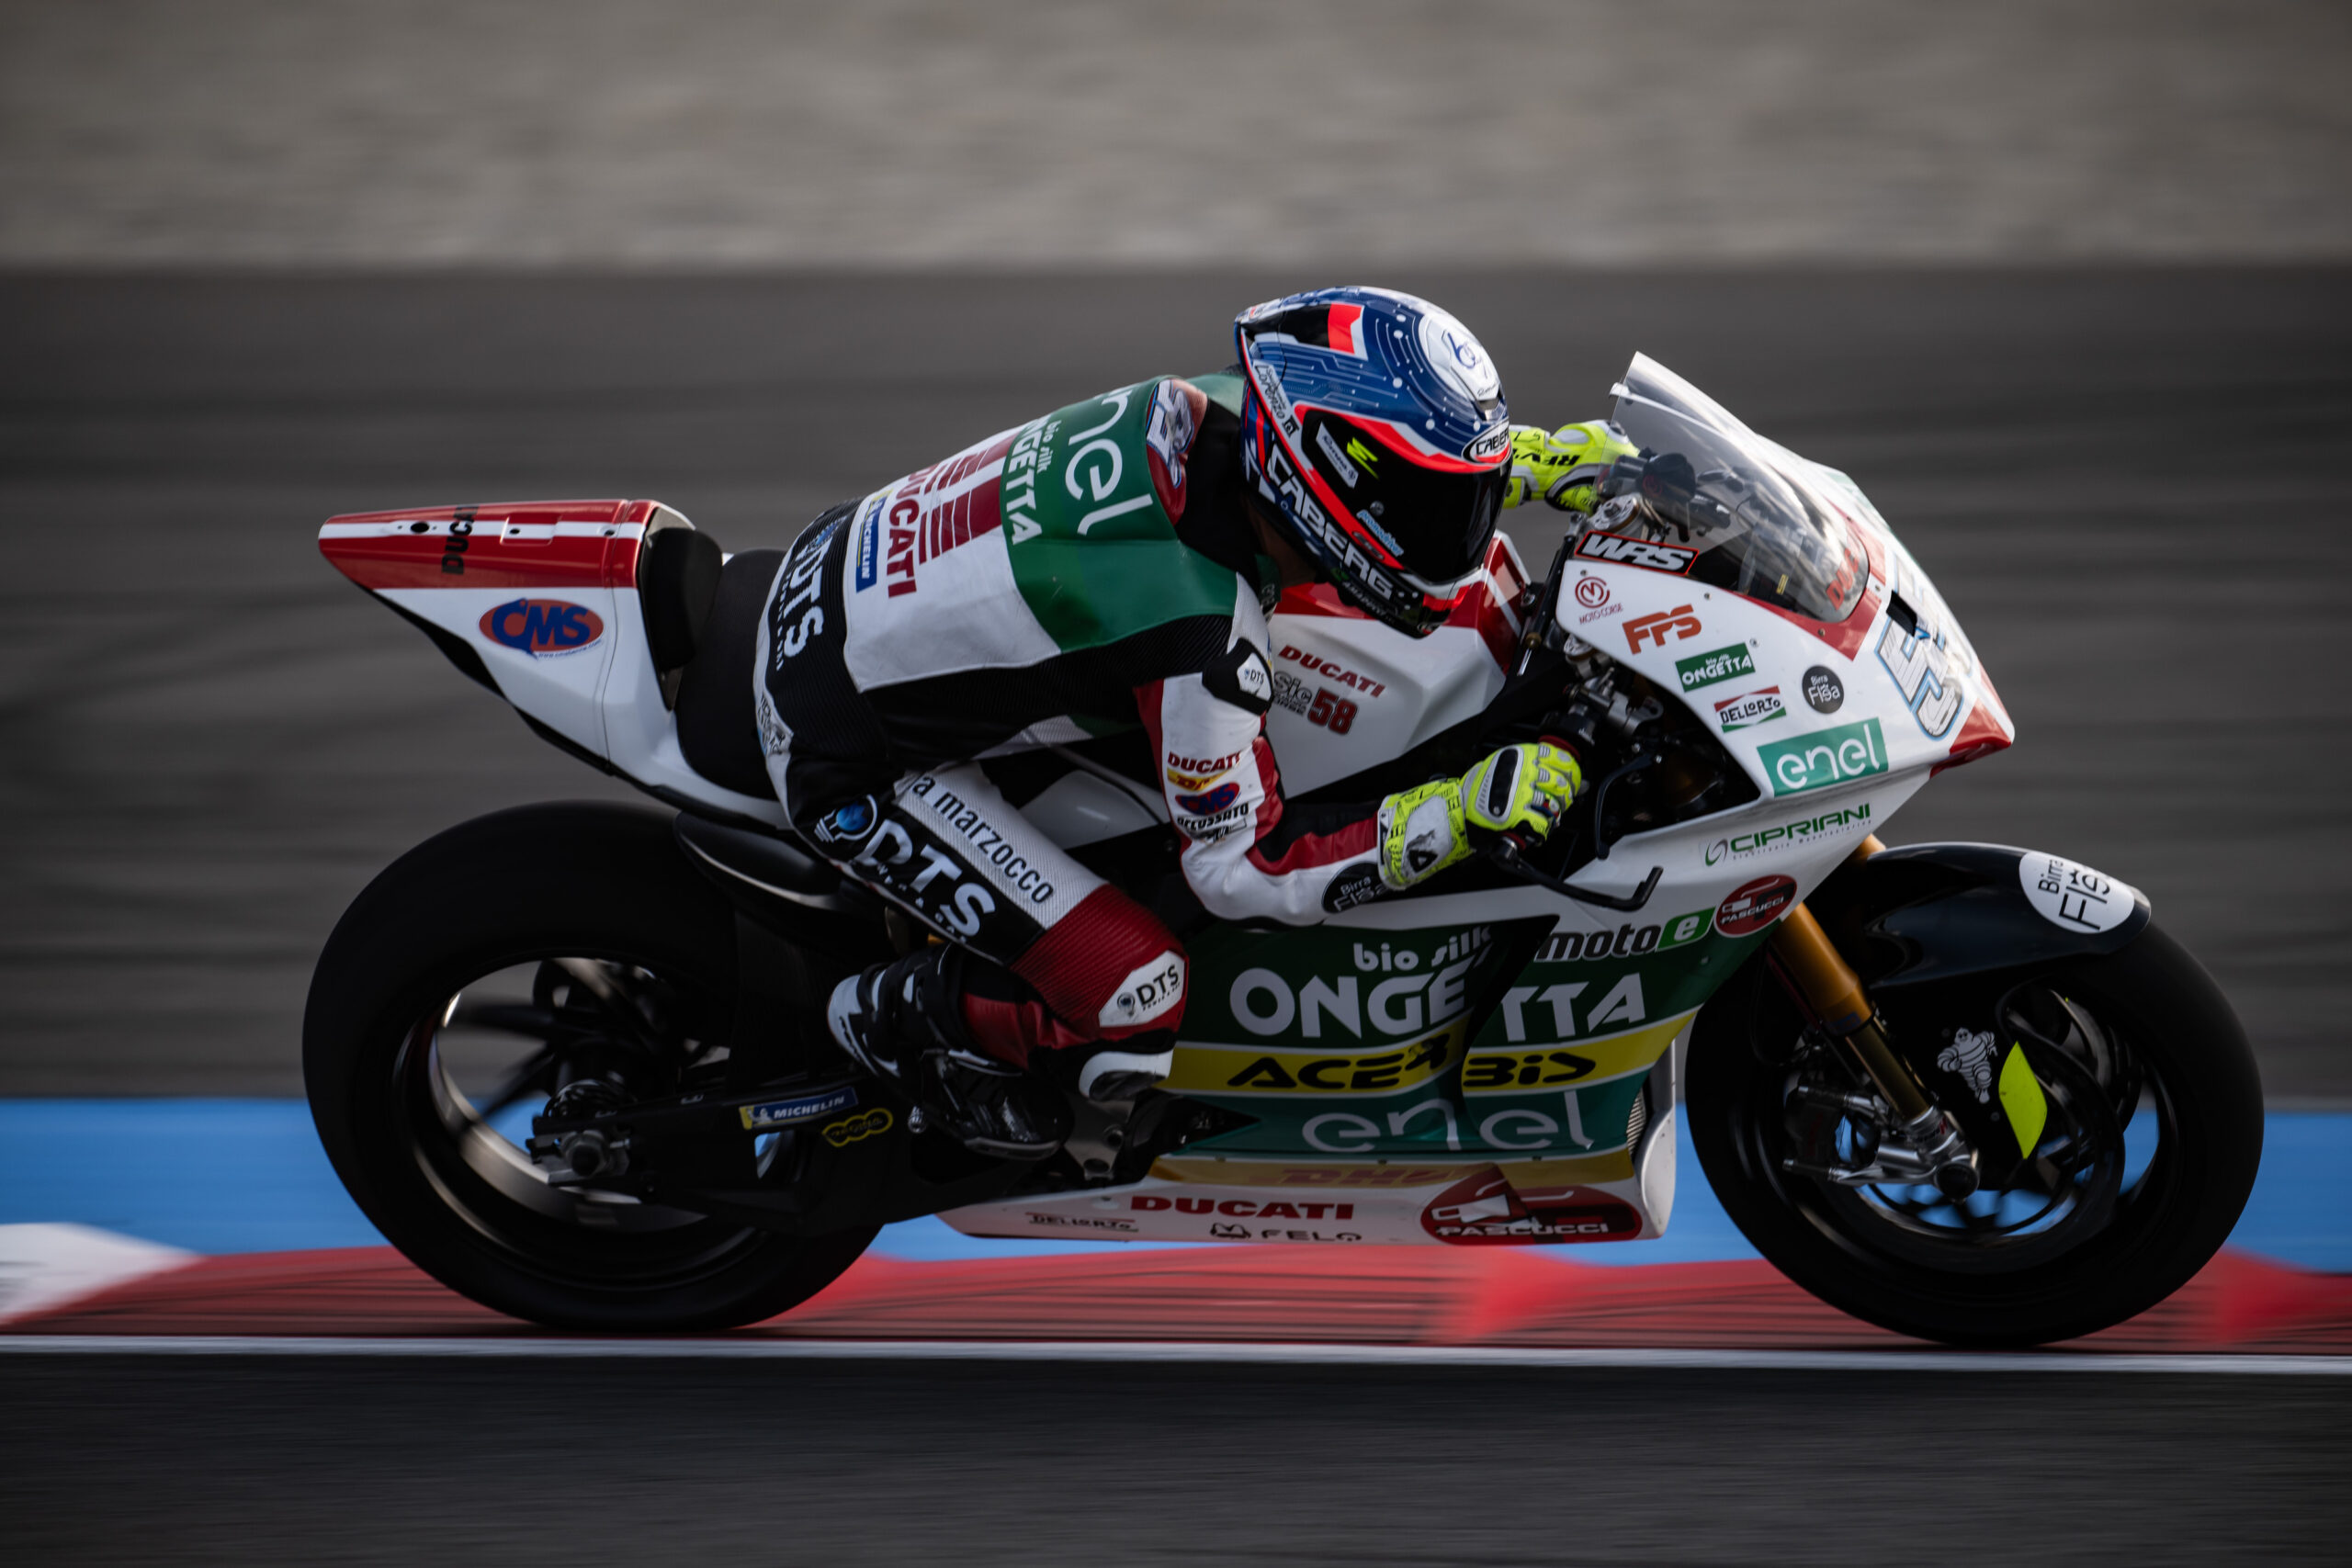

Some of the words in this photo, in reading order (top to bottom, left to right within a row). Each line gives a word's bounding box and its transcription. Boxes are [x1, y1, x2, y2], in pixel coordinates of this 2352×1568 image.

[1006, 414, 1043, 546] NGETTA
[1065, 389, 1154, 536] nel
[1266, 443, 1394, 600] CABERG
[1581, 534, 1695, 571] WRS
[492, 598, 591, 660] CMS
[1623, 604, 1702, 655] FPS
[1250, 670, 1265, 685] DTS
[1278, 645, 1387, 698] DUCATI
[1681, 654, 1753, 685] ONGETTA
[1307, 687, 1358, 734] 58
[1168, 751, 1241, 773] DUCATI
[1776, 723, 1880, 789] enel
[933, 792, 1055, 904] marzocco
[1730, 803, 1871, 852] CIPRIANI
[853, 818, 997, 938] DTS
[1720, 895, 1786, 925] PASCUCCI
[1353, 942, 1419, 973] bio
[1430, 924, 1492, 968] silk
[1136, 964, 1179, 1006] DTS
[774, 1094, 845, 1120] MICHELIN
[1301, 1090, 1595, 1153] enel
[1131, 1196, 1355, 1220] DUCATI
[1435, 1222, 1611, 1237] PASCUCCI
